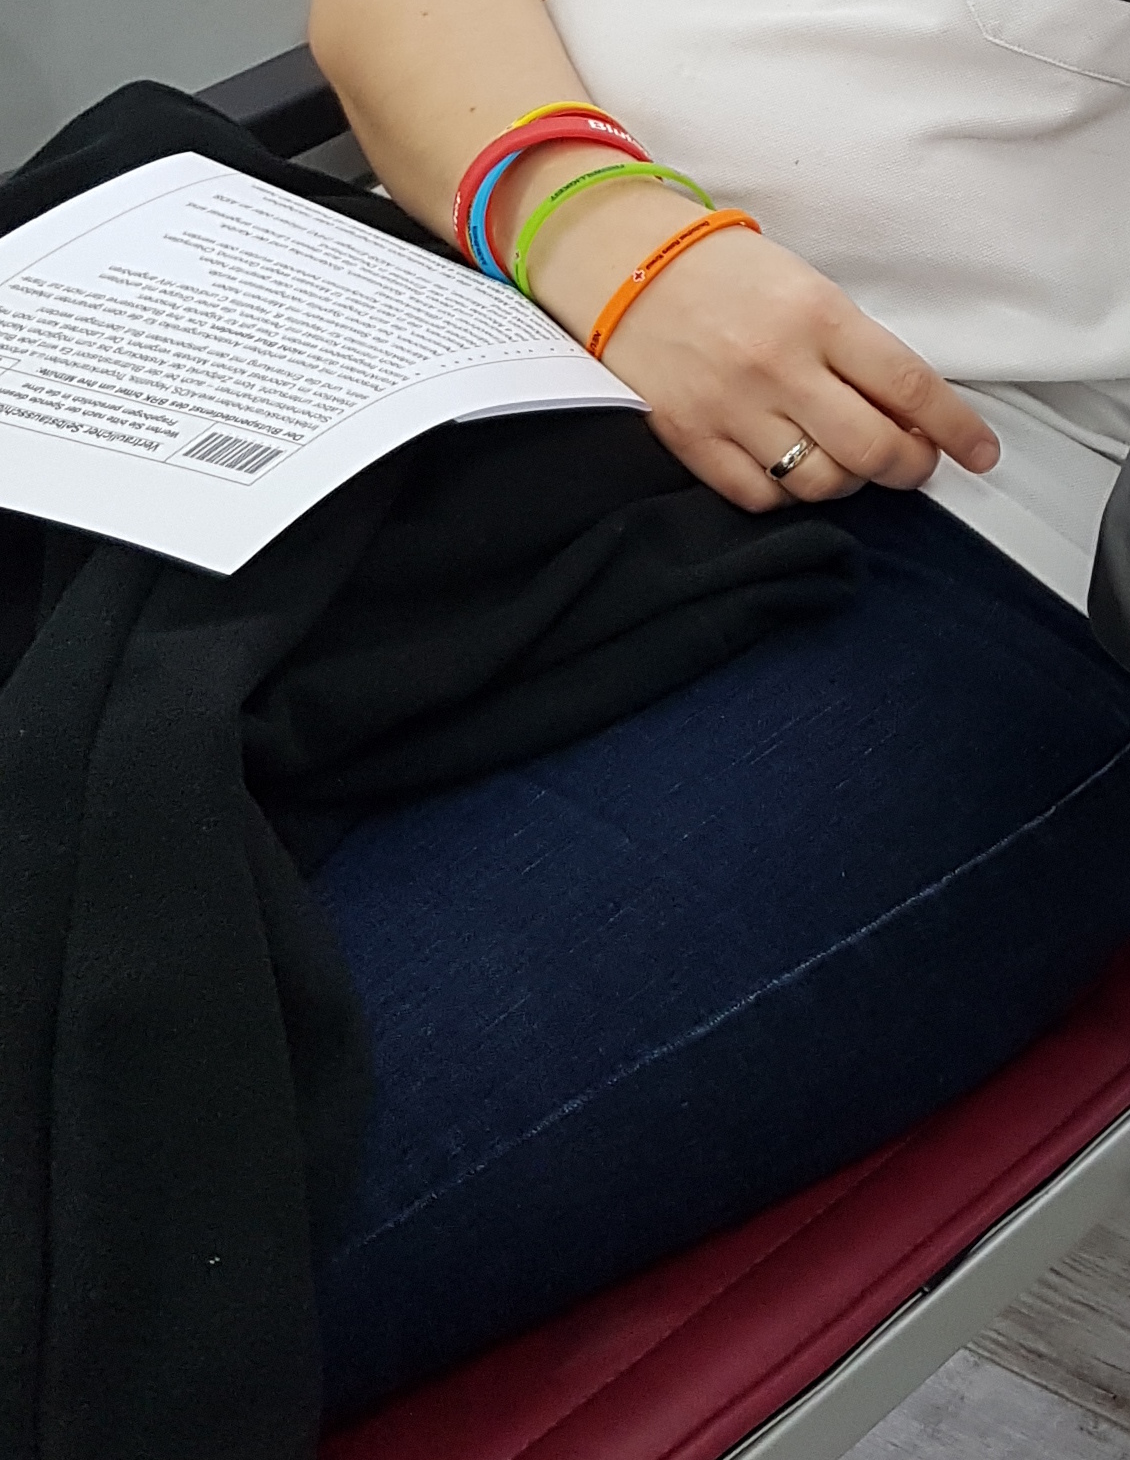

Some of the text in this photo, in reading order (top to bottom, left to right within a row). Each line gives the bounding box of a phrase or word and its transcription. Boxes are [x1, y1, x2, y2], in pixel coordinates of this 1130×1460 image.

[168, 400, 191, 410] des
[187, 405, 284, 436] Blutspendedienst
[281, 431, 305, 442] Der
